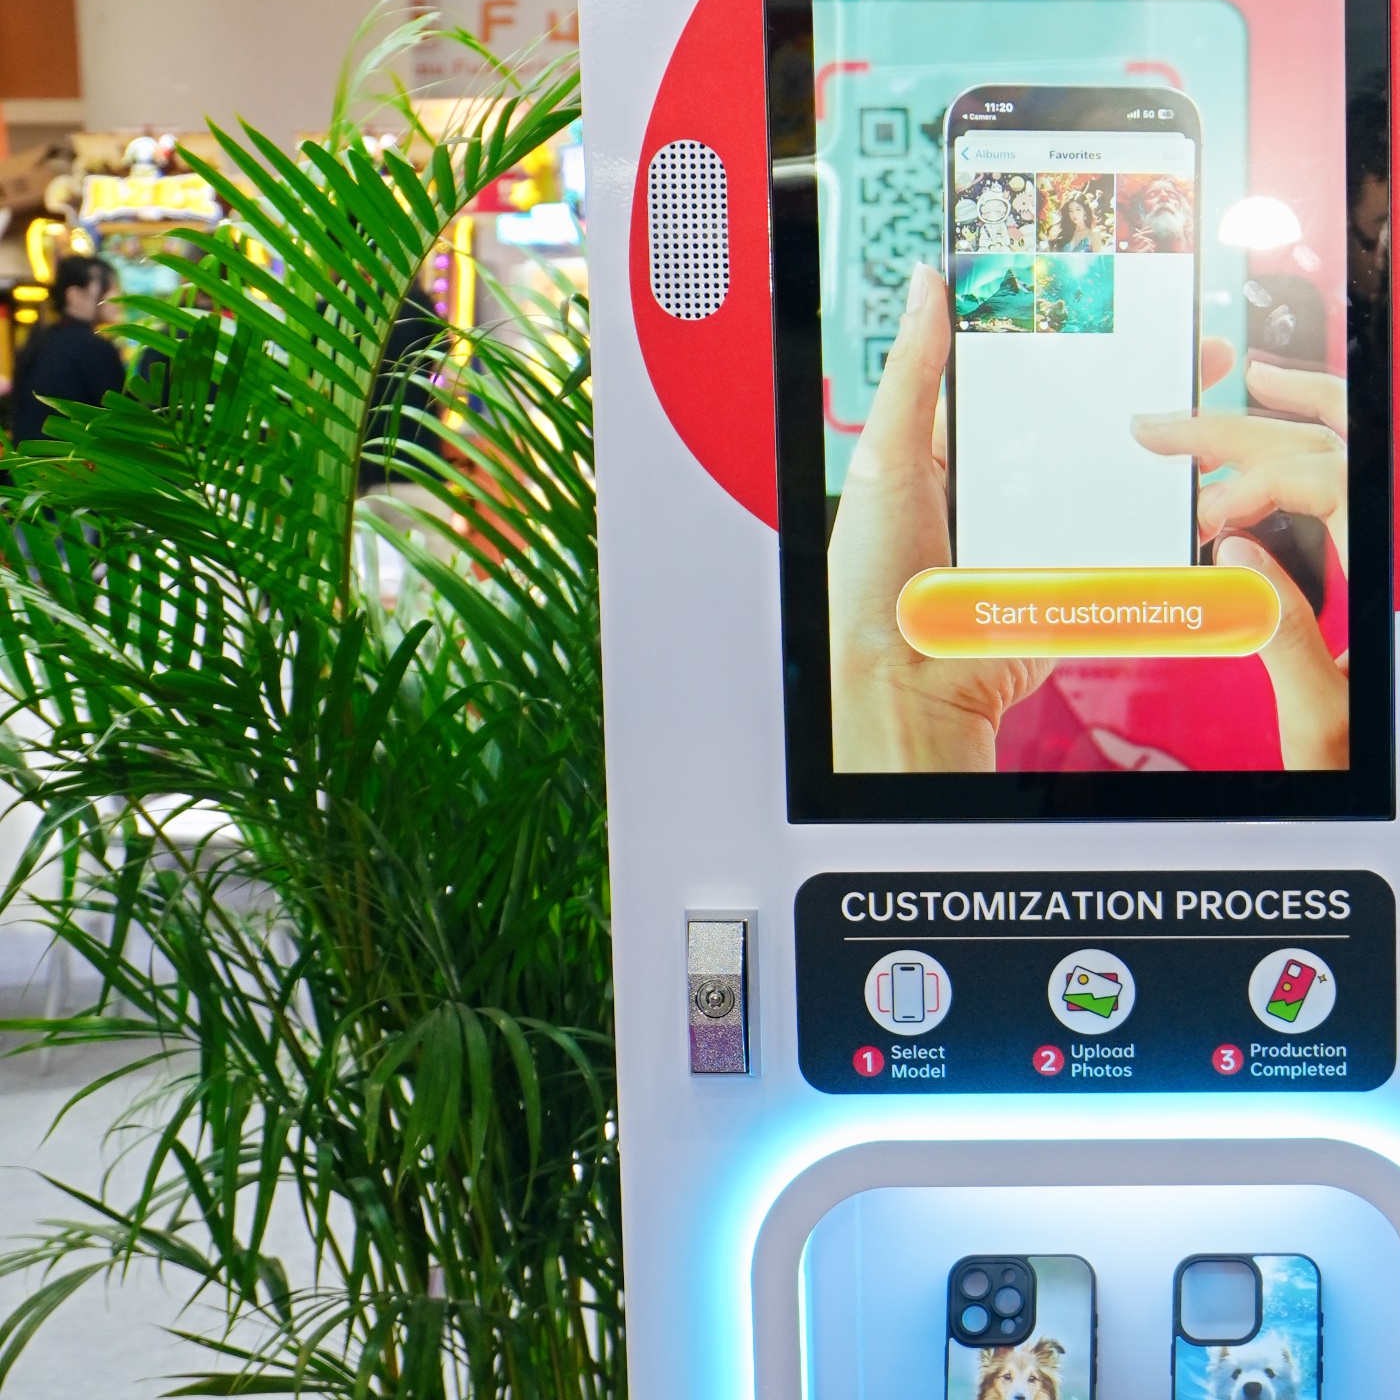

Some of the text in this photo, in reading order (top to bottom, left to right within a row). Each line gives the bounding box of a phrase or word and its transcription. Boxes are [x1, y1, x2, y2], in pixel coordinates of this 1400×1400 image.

[984, 101, 1014, 114] 11:20
[969, 113, 997, 122] Camera
[975, 149, 1016, 161] Albums
[1049, 150, 1102, 161] Favorites
[974, 600, 1203, 630] Start customizing
[840, 888, 1352, 922] CUSTOMIZATION PROCESS
[890, 1043, 946, 1061] Select
[1071, 1043, 1135, 1063] Upload
[1250, 1042, 1347, 1059] Production
[890, 1063, 946, 1080] Model
[1071, 1062, 1133, 1079] Photos
[1250, 1060, 1348, 1080] Completed
